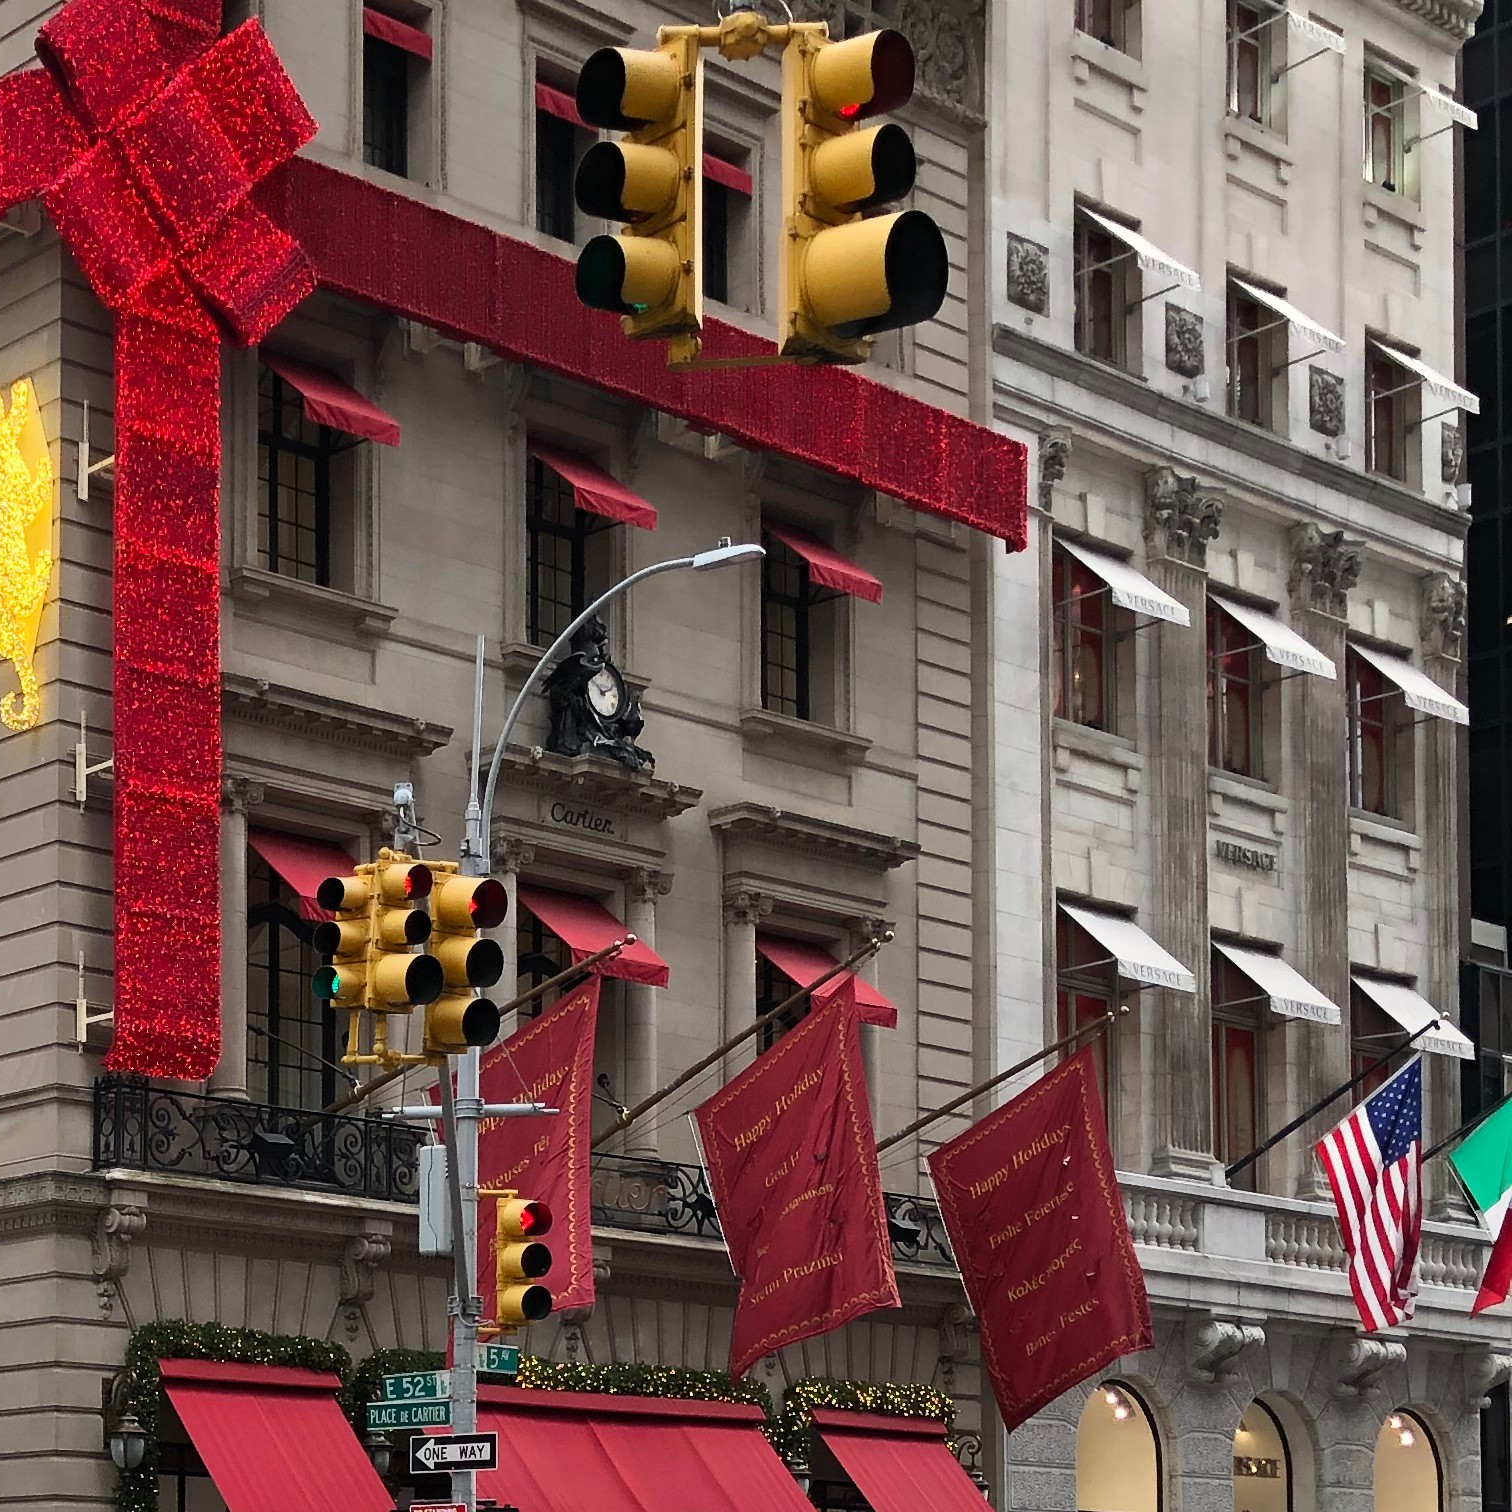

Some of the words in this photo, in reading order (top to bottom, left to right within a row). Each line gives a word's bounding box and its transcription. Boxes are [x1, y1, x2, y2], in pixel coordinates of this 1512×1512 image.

[551, 803, 614, 834] Cartier
[1216, 839, 1278, 872] VERSACE
[1133, 962, 1182, 986] VERSACE
[1283, 1000, 1329, 1020] VERSACE
[734, 1112, 772, 1152] Happy
[969, 1163, 1010, 1199] Happy
[490, 1348, 499, 1369] 5
[386, 1379, 397, 1398] E
[403, 1376, 426, 1398] 52
[426, 1375, 437, 1386] ST
[370, 1408, 397, 1424] PLACE
[411, 1405, 446, 1422] CARTIER
[424, 1447, 448, 1460] ONE
[459, 1445, 485, 1459] WAY
